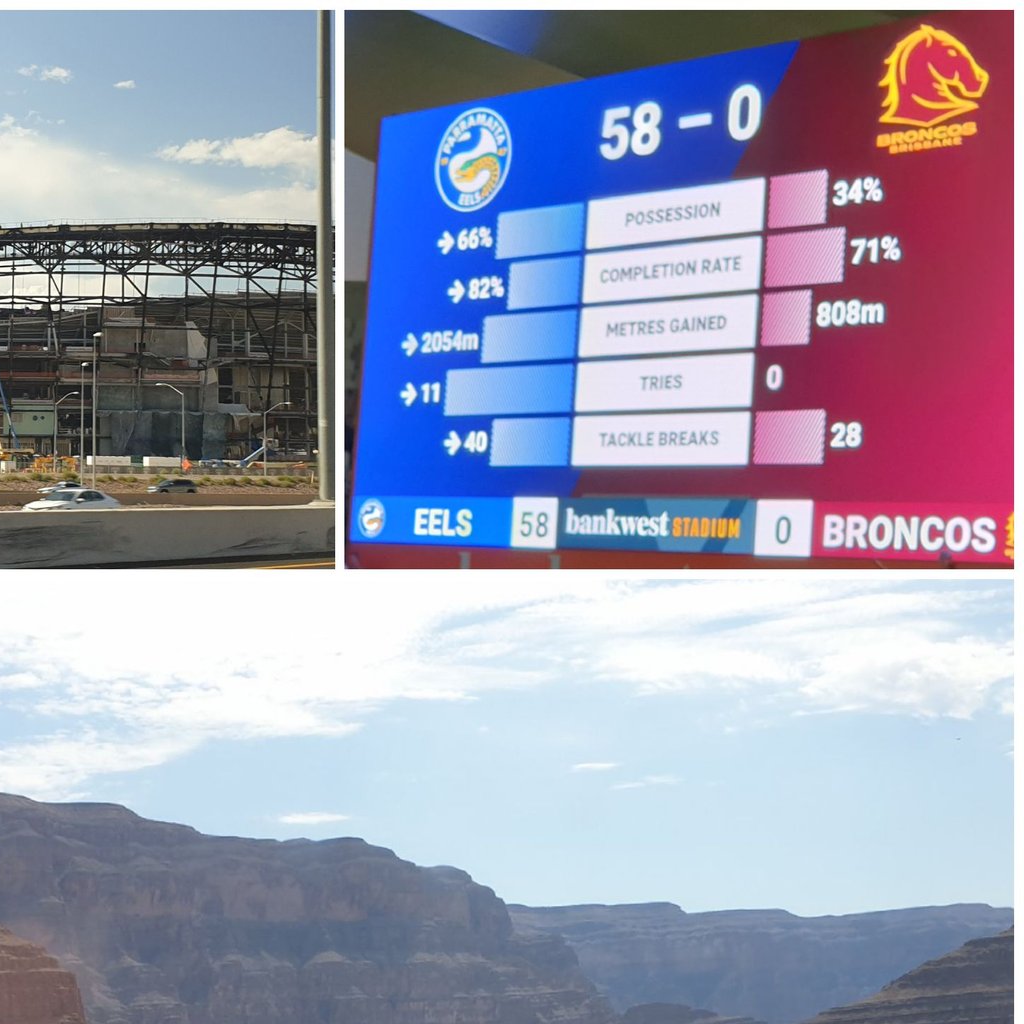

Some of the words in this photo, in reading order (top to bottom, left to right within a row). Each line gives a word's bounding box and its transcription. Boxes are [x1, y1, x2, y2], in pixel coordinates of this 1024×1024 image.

[599, 101, 662, 160] 58
[728, 84, 762, 141] 0
[876, 121, 977, 148] BRONCOS
[832, 176, 884, 206] 34%
[625, 202, 721, 227] POSSESSION
[456, 226, 493, 251] 66%
[849, 235, 902, 265] 71%
[599, 261, 697, 284] COMPLETION
[701, 256, 742, 274] RATE
[467, 275, 505, 301] 82%
[605, 320, 665, 338] METRES
[670, 315, 727, 333] GAINED
[815, 299, 885, 327] 808m
[420, 330, 480, 353] 2054m
[639, 375, 683, 391] TRIES
[766, 364, 784, 390] 0
[421, 382, 441, 403] 11
[463, 430, 489, 453] 40
[599, 432, 655, 448] TACKLE
[658, 430, 720, 446] BREAKS
[830, 421, 863, 448] 28
[413, 507, 473, 537] EELS
[520, 511, 549, 539] 58
[565, 506, 670, 537] bankwest
[672, 517, 741, 539] STADIUM
[775, 515, 792, 544] 0
[822, 513, 997, 554] BRONCOS
